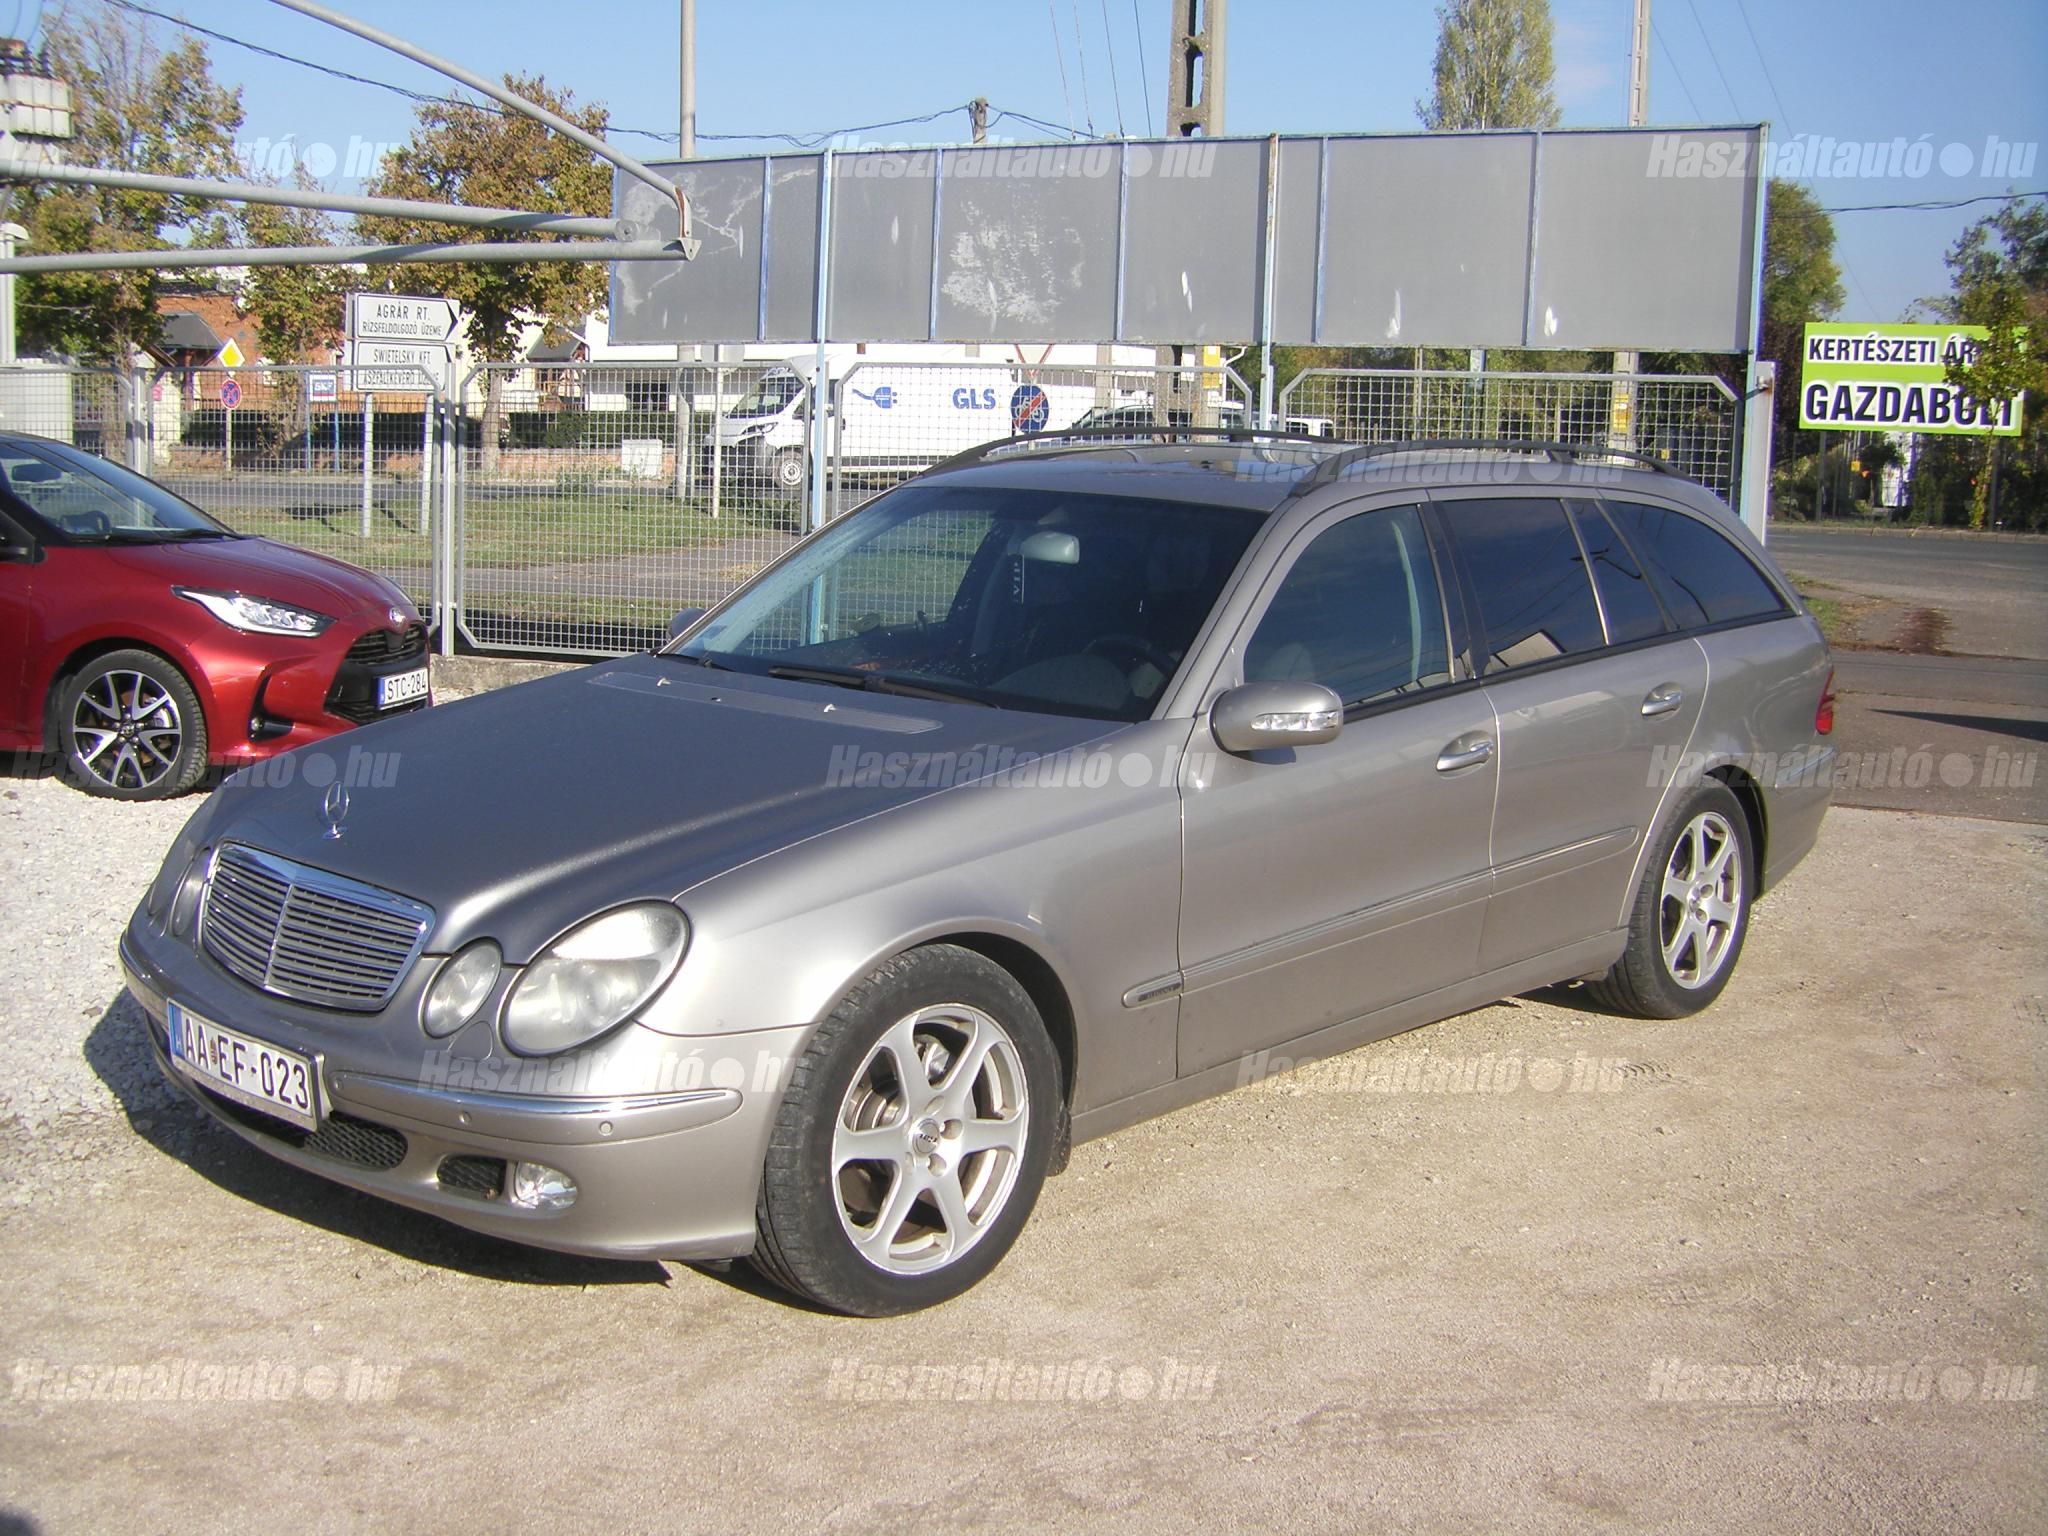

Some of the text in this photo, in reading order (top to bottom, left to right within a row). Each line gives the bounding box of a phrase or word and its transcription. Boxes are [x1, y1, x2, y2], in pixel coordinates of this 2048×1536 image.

[377, 301, 409, 319] AGRÁR
[1809, 334, 1936, 363] KERTÉSZETI
[952, 388, 997, 410] GLS
